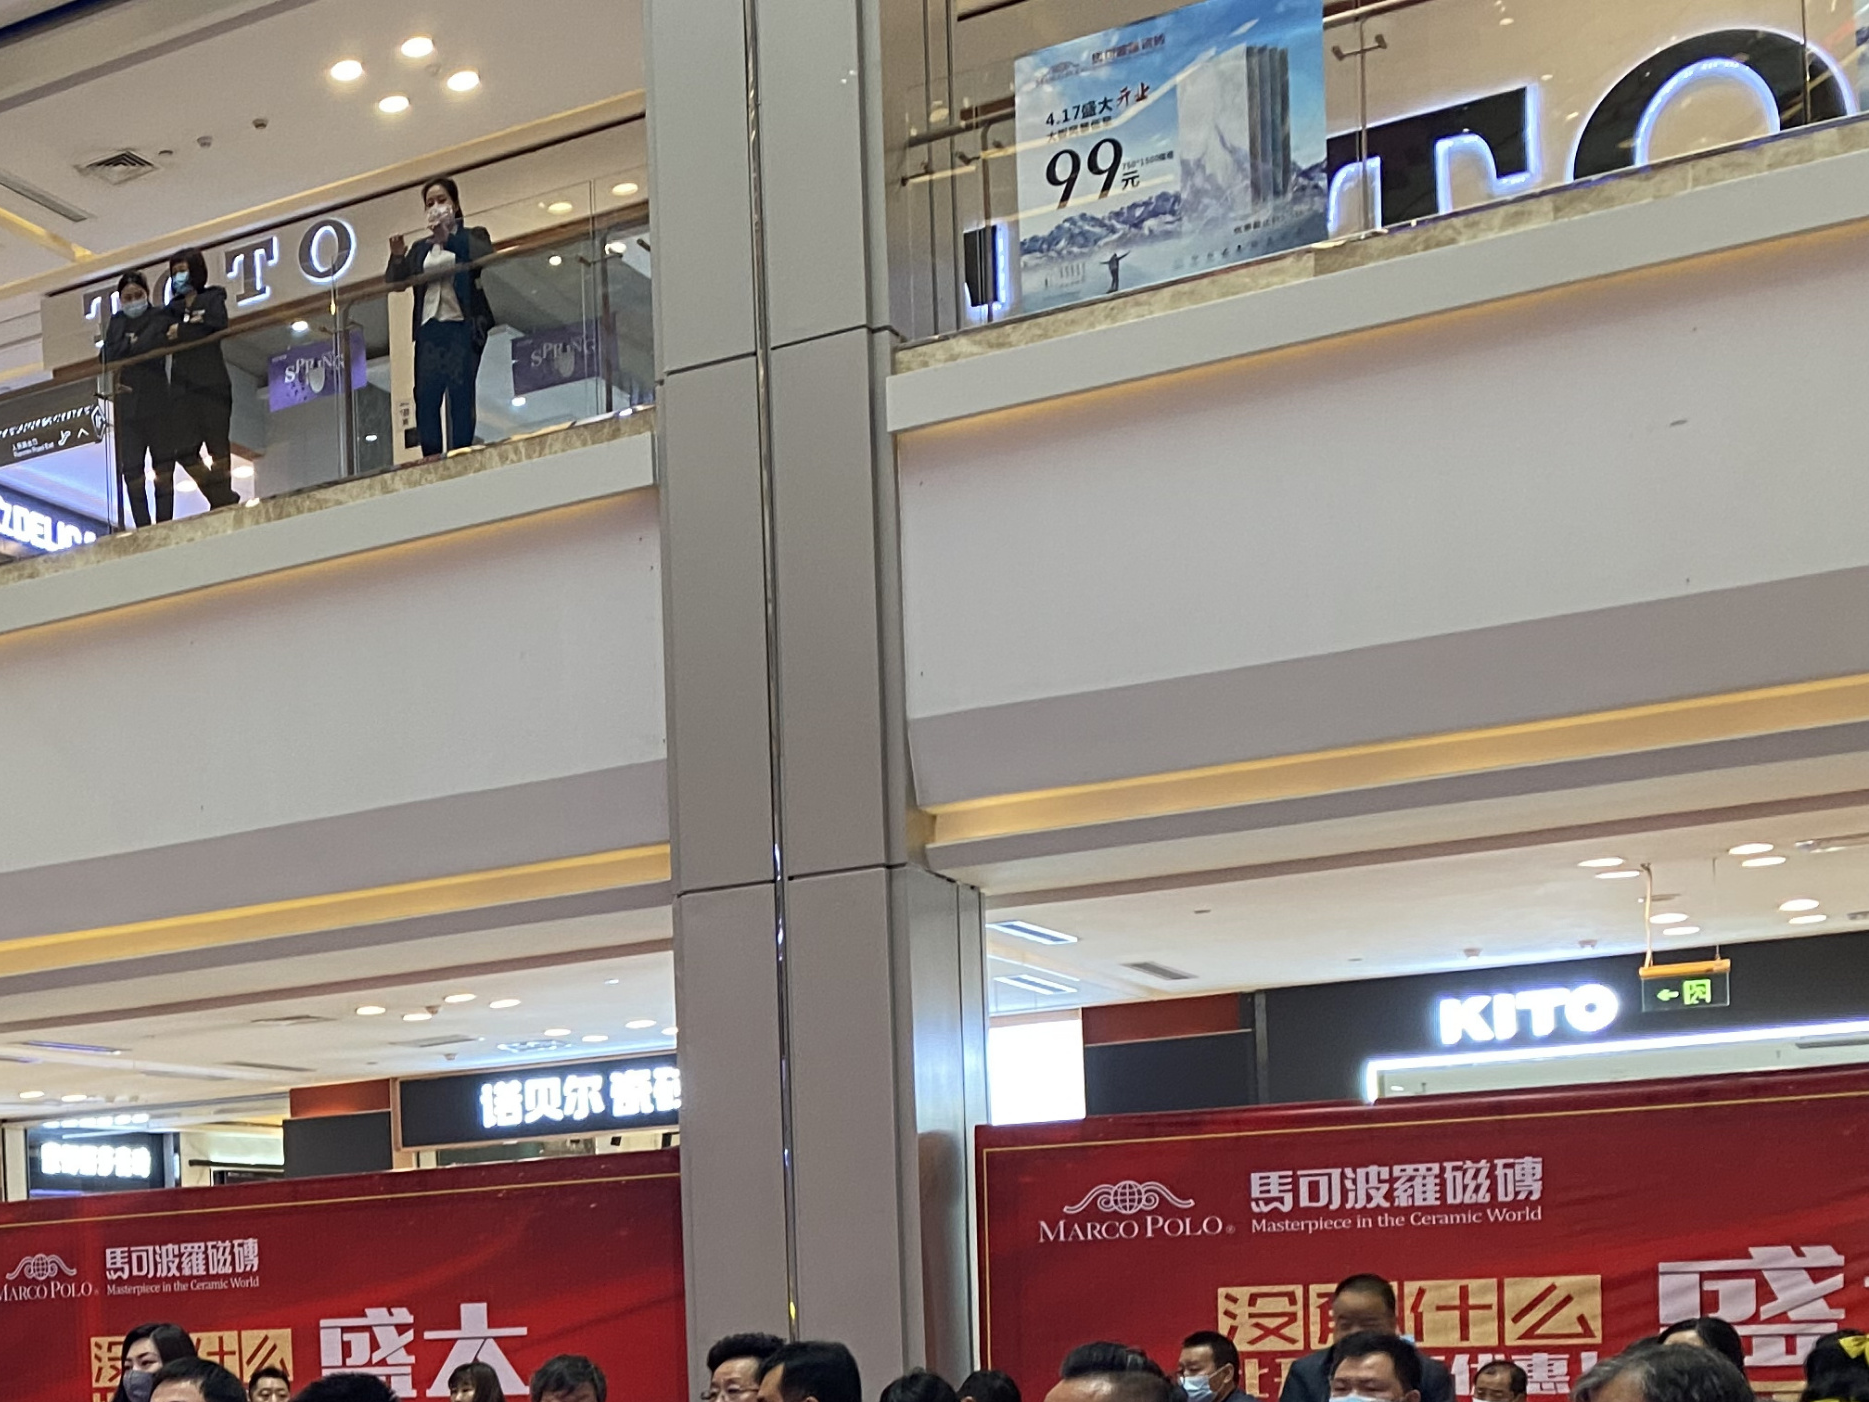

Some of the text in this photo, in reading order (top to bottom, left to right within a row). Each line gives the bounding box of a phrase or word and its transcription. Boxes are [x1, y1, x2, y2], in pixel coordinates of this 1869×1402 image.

[1440, 983, 1619, 1045] KITO
[1038, 1213, 1223, 1243] MARCO POLO
[1251, 1206, 1543, 1234] Masterpiece in the Ceramic World
[50, 1281, 93, 1299] POLO
[107, 1276, 260, 1297] Masterpiece in the Ceramic World
[1224, 1283, 1595, 1347] 没什么
